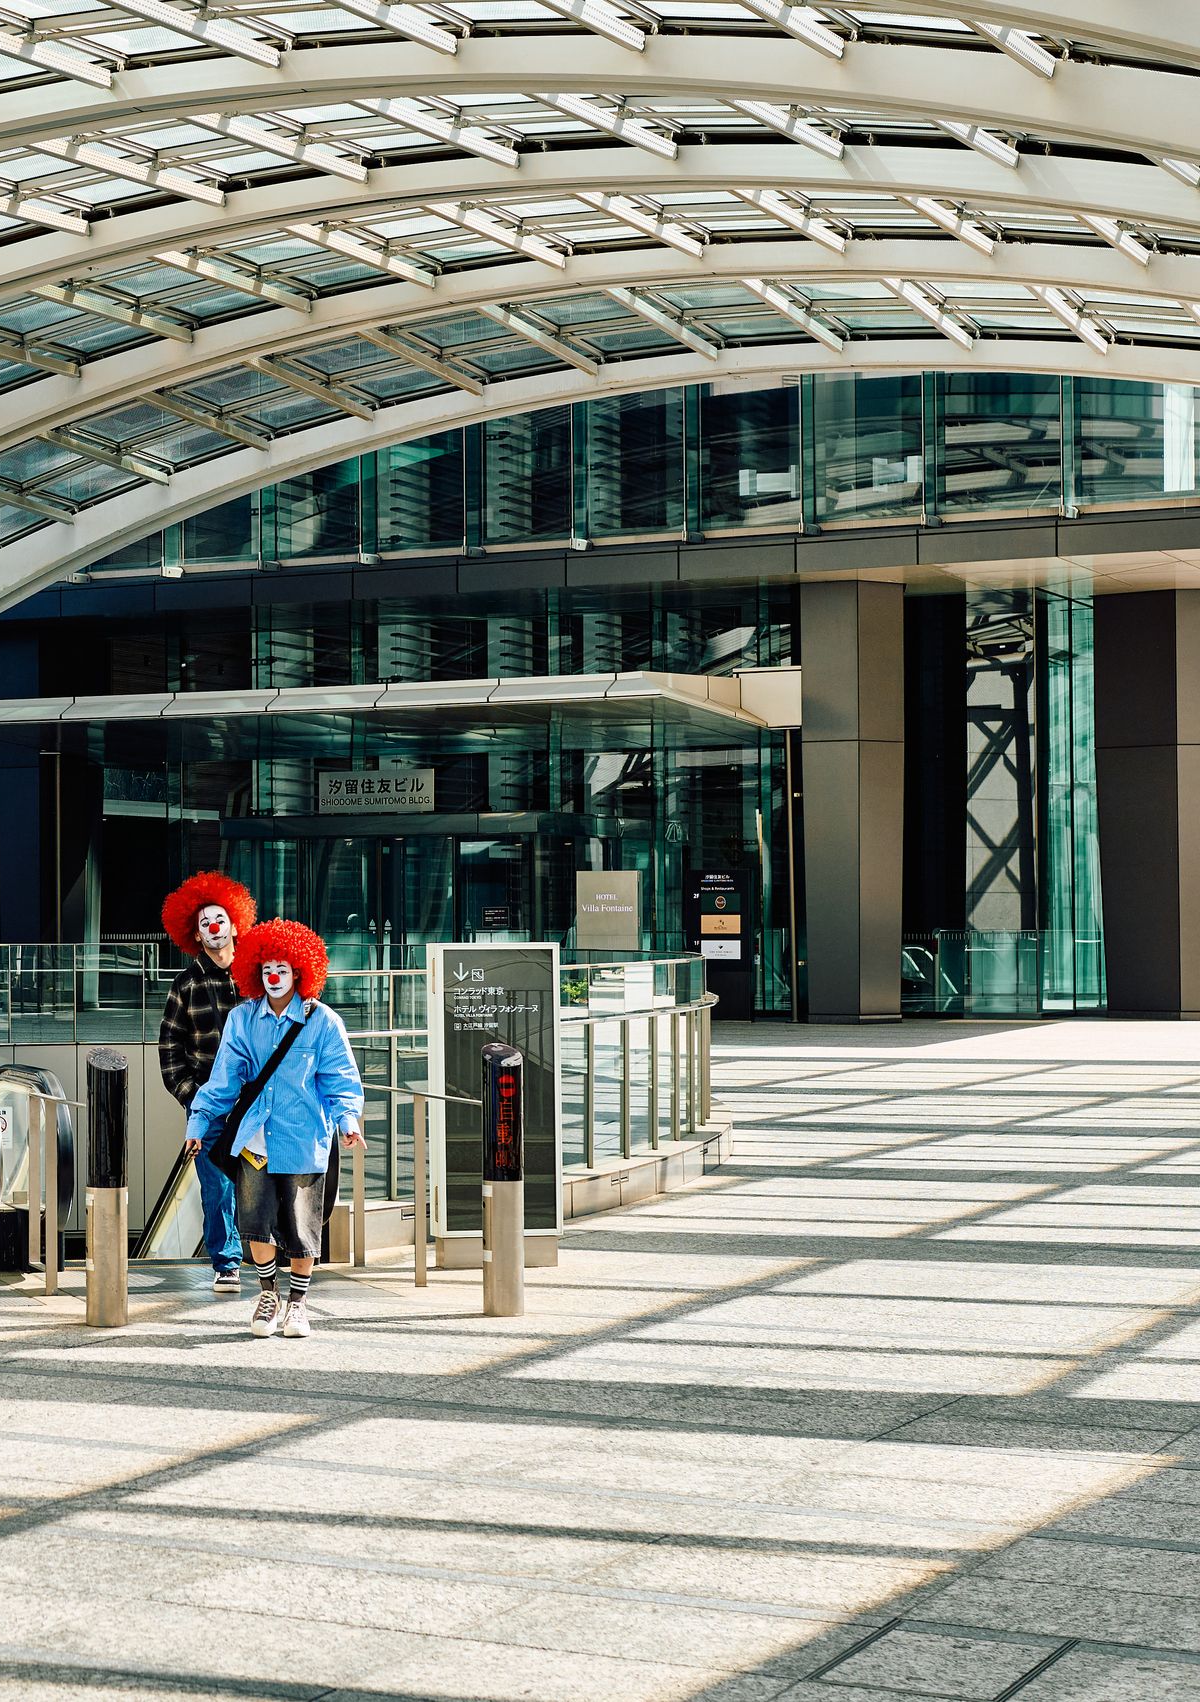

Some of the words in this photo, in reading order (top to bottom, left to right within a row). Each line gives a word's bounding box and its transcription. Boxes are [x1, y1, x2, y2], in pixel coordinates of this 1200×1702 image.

[329, 778, 424, 794] 汐留住友ビル
[321, 797, 362, 806] SHIODOME
[364, 796, 407, 805] SUMITOMO
[408, 796, 433, 804] BLDG.
[595, 893, 618, 901] HOTEL
[581, 903, 600, 912] Villa
[601, 903, 634, 912] Fontaine
[453, 987, 505, 995] コンラッド東京
[453, 1005, 477, 1013] ホテル
